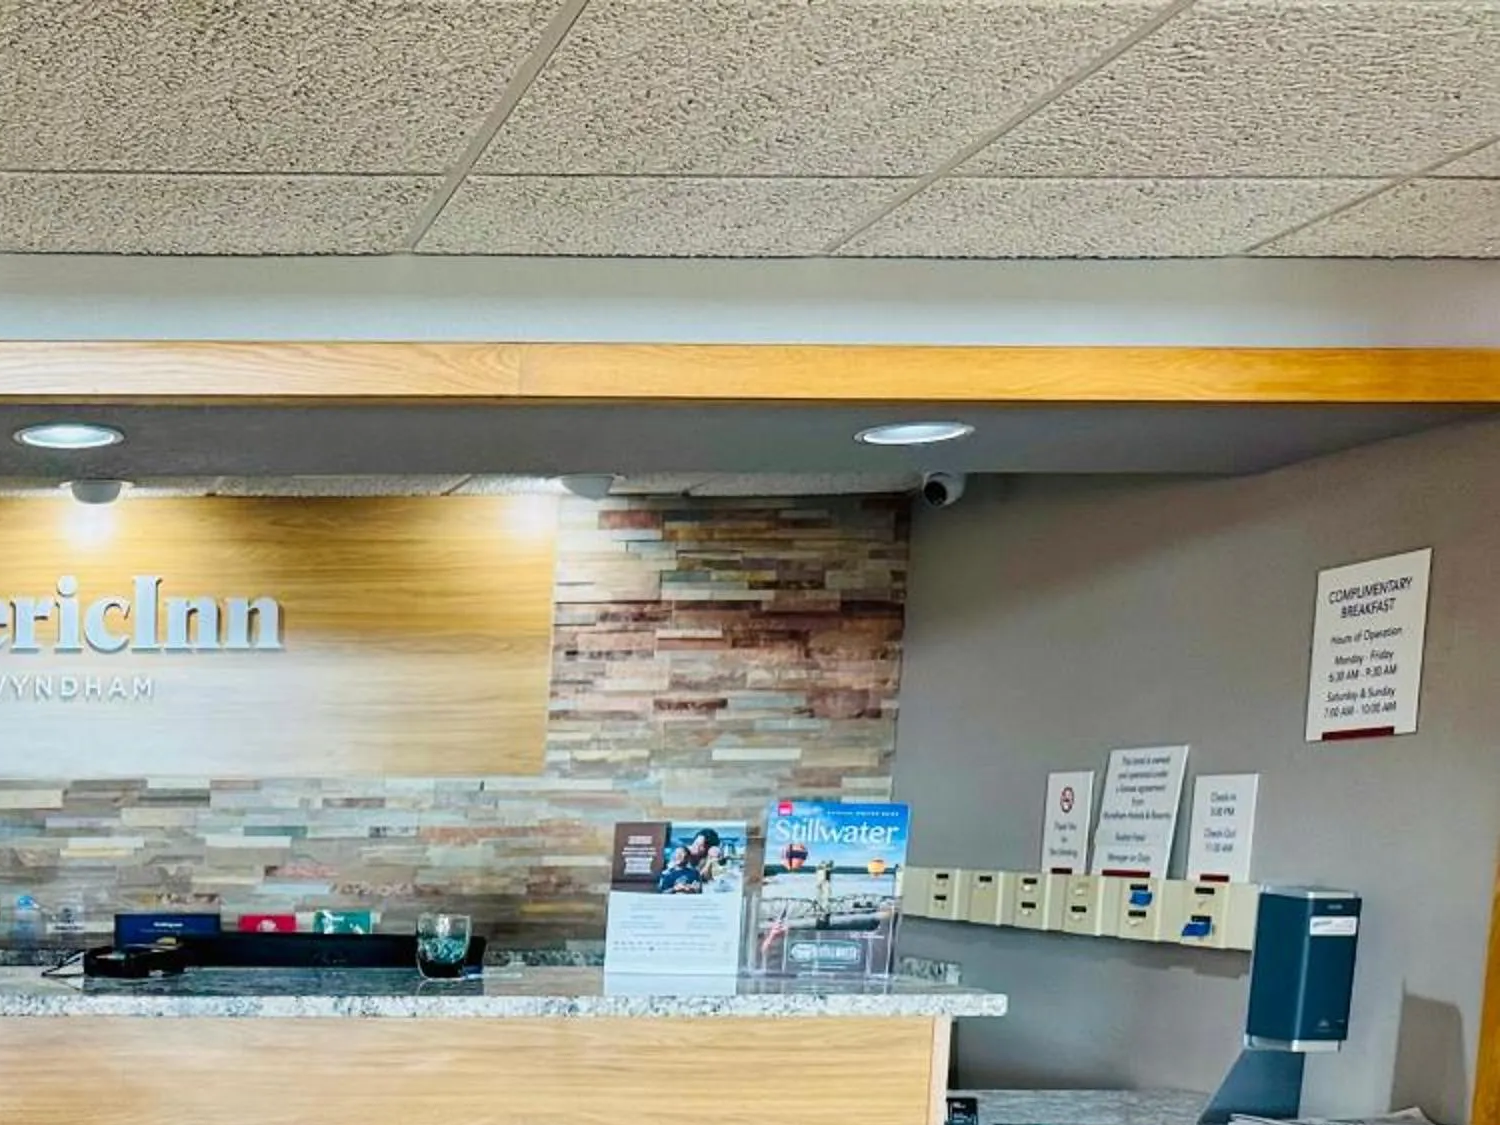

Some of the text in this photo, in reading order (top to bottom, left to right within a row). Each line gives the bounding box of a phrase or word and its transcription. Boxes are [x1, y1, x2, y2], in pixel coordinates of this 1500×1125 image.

[1329, 576, 1412, 604] COMPLIMENTARY
[1340, 598, 1396, 618] BREAKFAST
[1363, 627, 1402, 641] Operation
[1334, 655, 1363, 666] Monday
[1370, 649, 1394, 661] Friday
[1346, 669, 1359, 680] AM
[1384, 664, 1397, 674] AM
[1327, 690, 1358, 702] Saturday
[1368, 687, 1396, 698] Sunday
[776, 816, 900, 845] Stillwater
